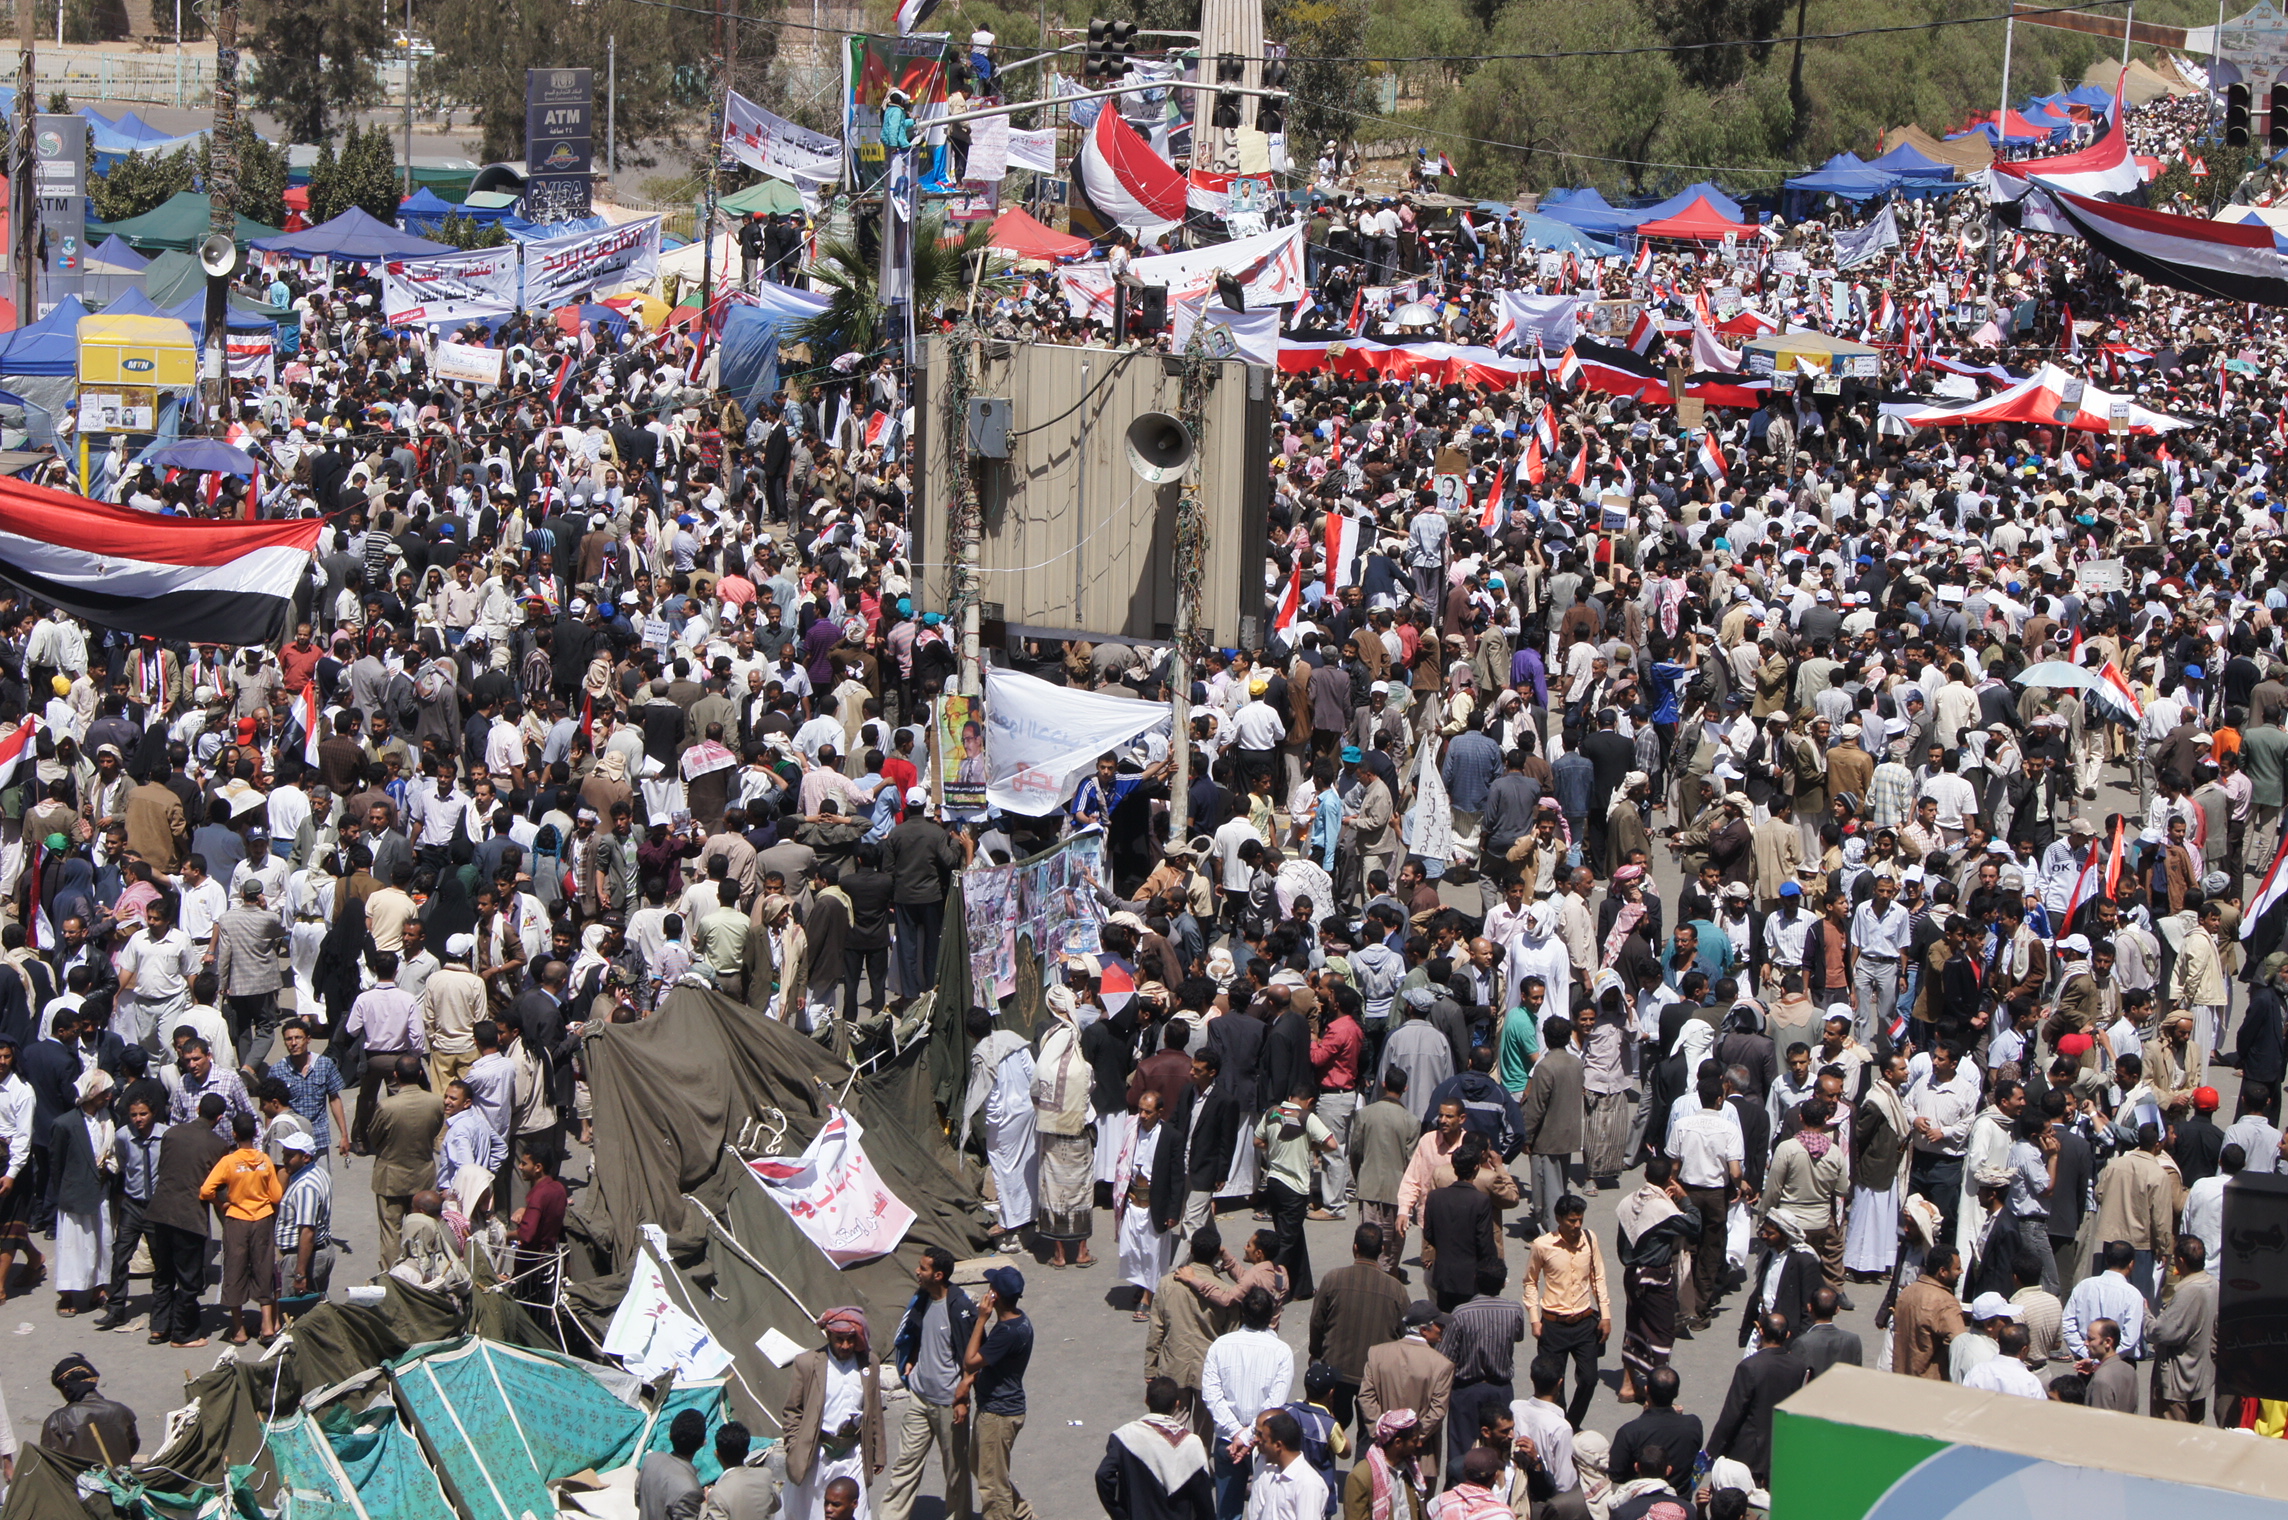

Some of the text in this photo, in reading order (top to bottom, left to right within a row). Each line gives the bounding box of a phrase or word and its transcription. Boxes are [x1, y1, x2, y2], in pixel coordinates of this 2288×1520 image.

[544, 109, 580, 125] ATM
[536, 180, 584, 202] VISA
[36, 198, 68, 211] ATM
[542, 228, 643, 274] الشعب يريد
[127, 360, 149, 370] MTN
[2052, 863, 2070, 872] OK
